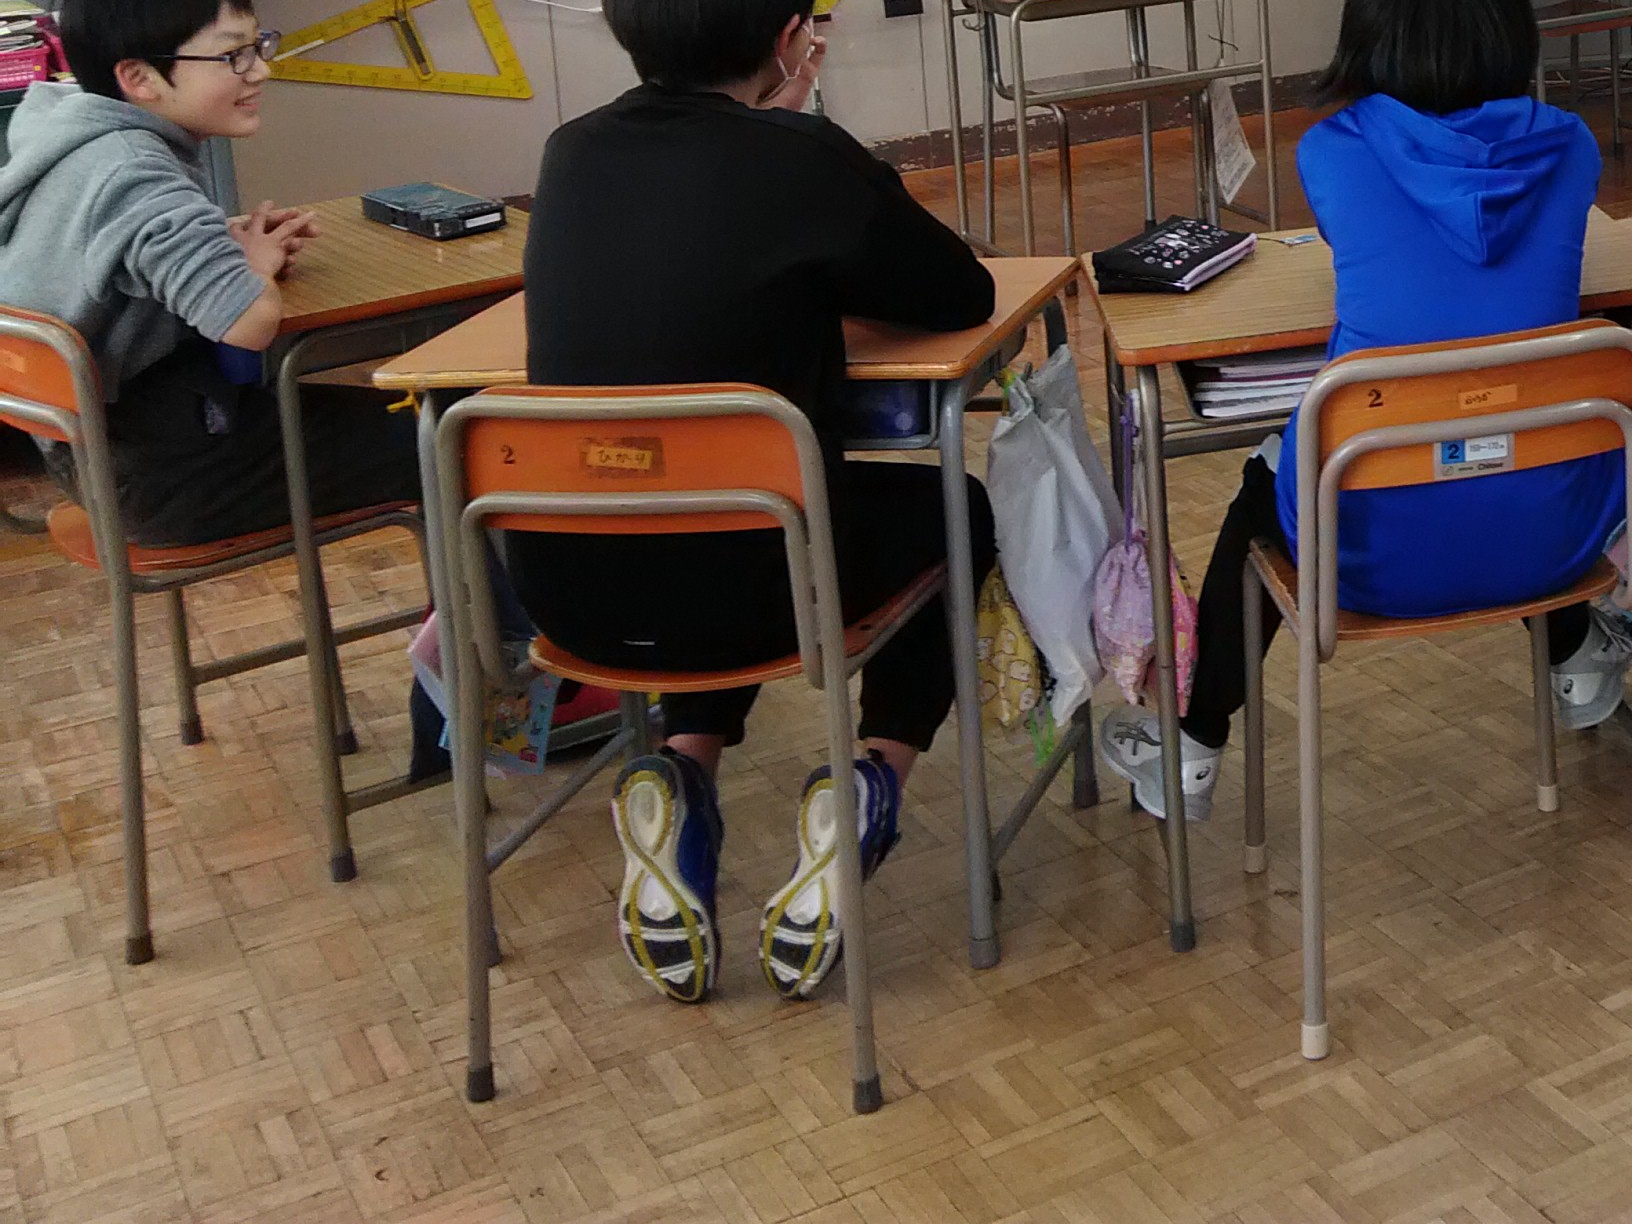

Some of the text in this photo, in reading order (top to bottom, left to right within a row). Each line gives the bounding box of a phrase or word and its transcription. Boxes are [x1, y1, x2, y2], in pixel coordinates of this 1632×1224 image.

[1368, 388, 1384, 408] 2
[500, 444, 516, 464] 2
[1448, 443, 1460, 460] 2
